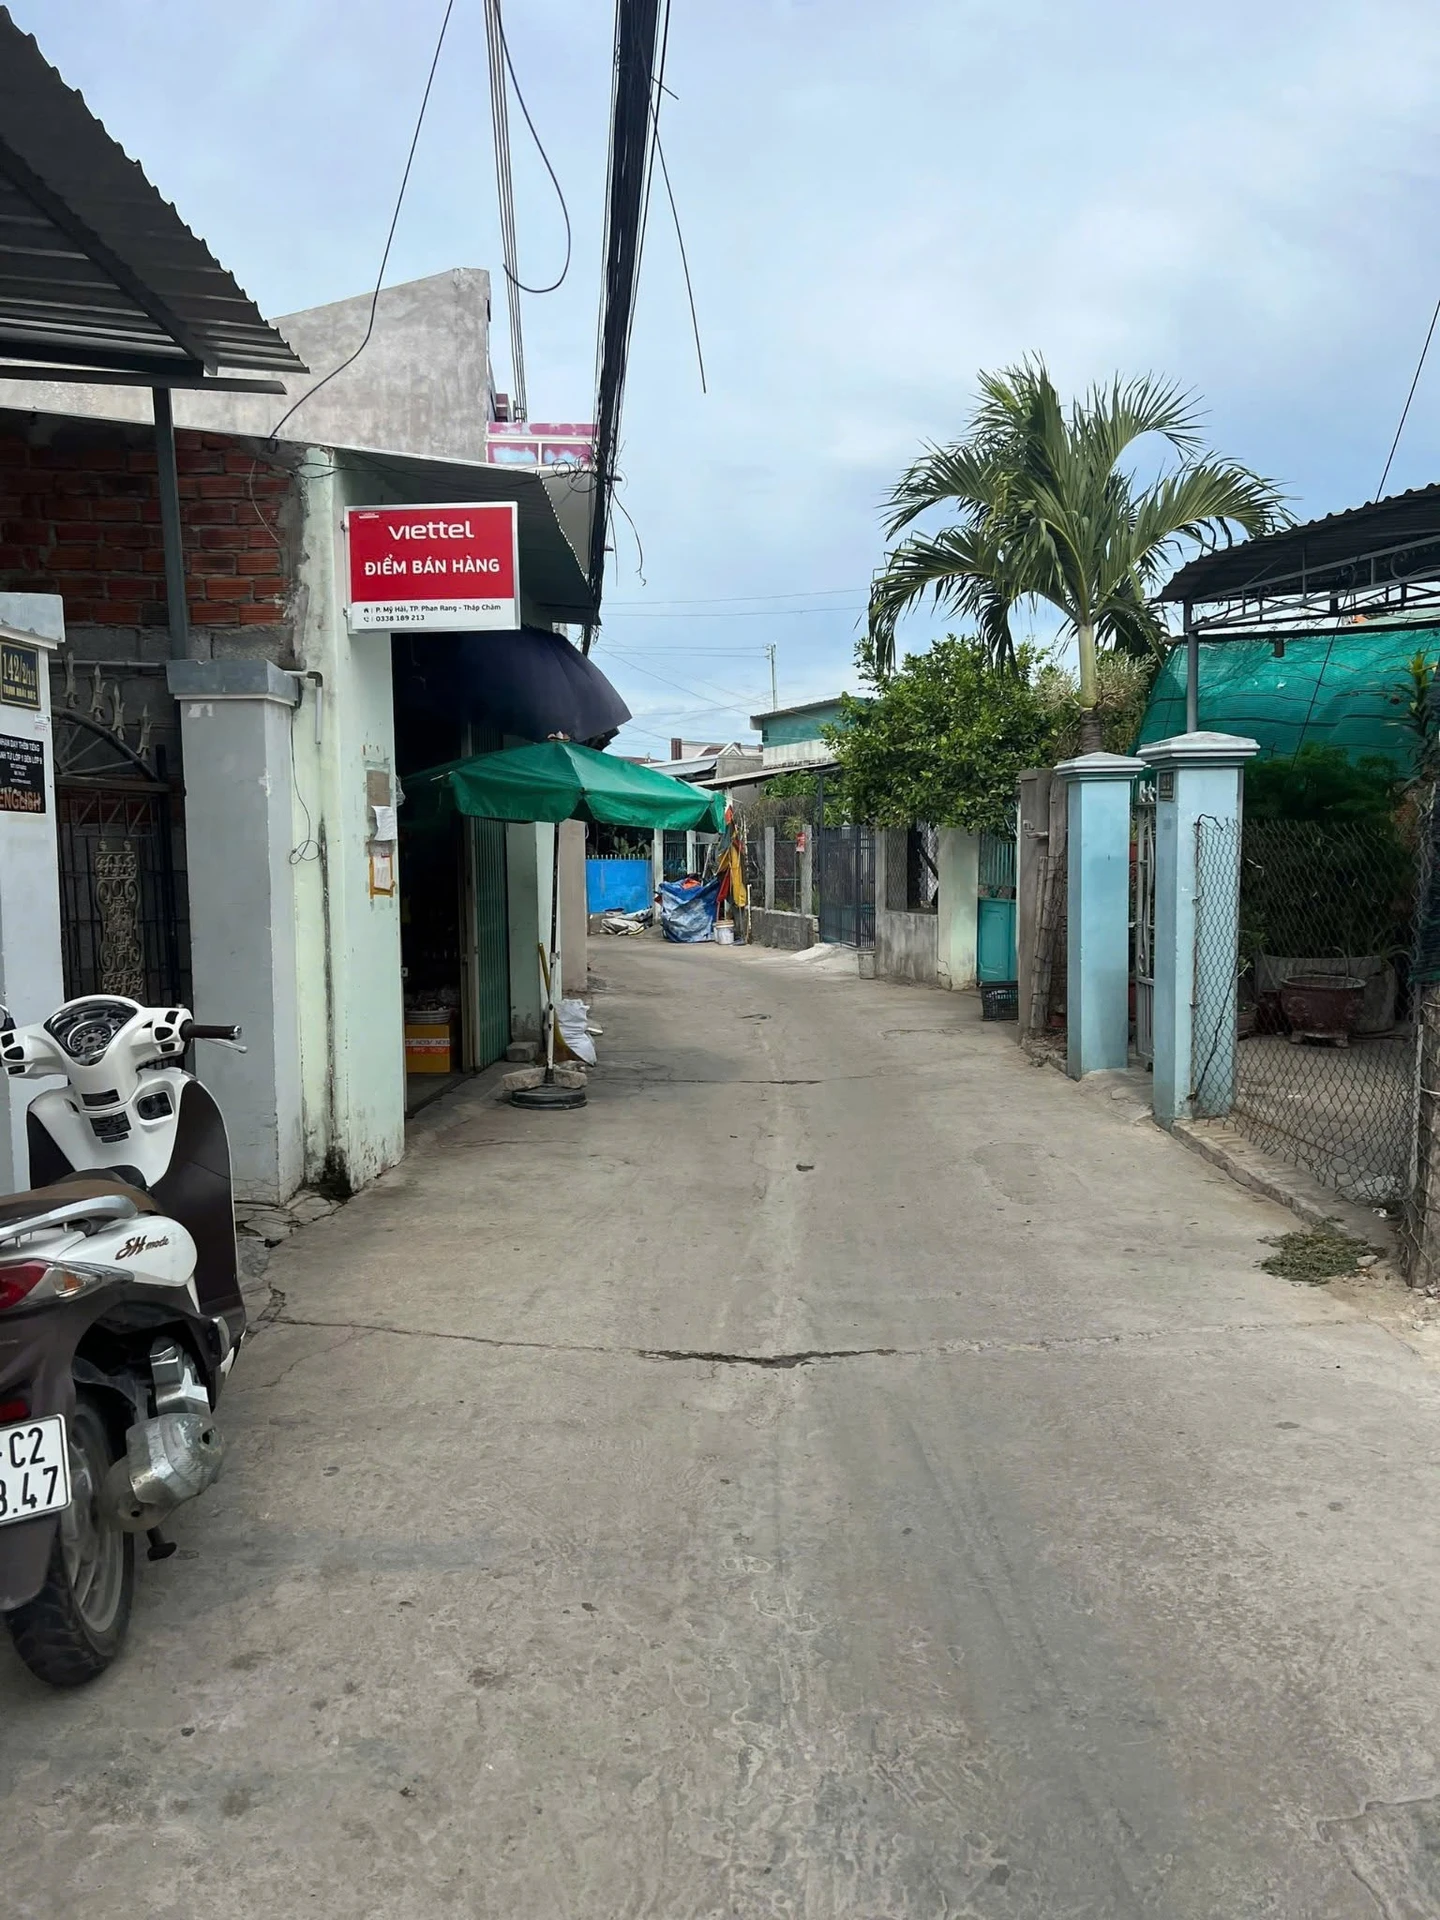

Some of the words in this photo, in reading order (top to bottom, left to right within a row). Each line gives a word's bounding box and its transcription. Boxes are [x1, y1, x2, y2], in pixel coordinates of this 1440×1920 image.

[388, 520, 475, 540] viettel
[364, 554, 407, 576] ĐIỂM
[412, 556, 447, 574] BÁN
[452, 555, 500, 573] HÀNG
[463, 604, 480, 612] Tháp
